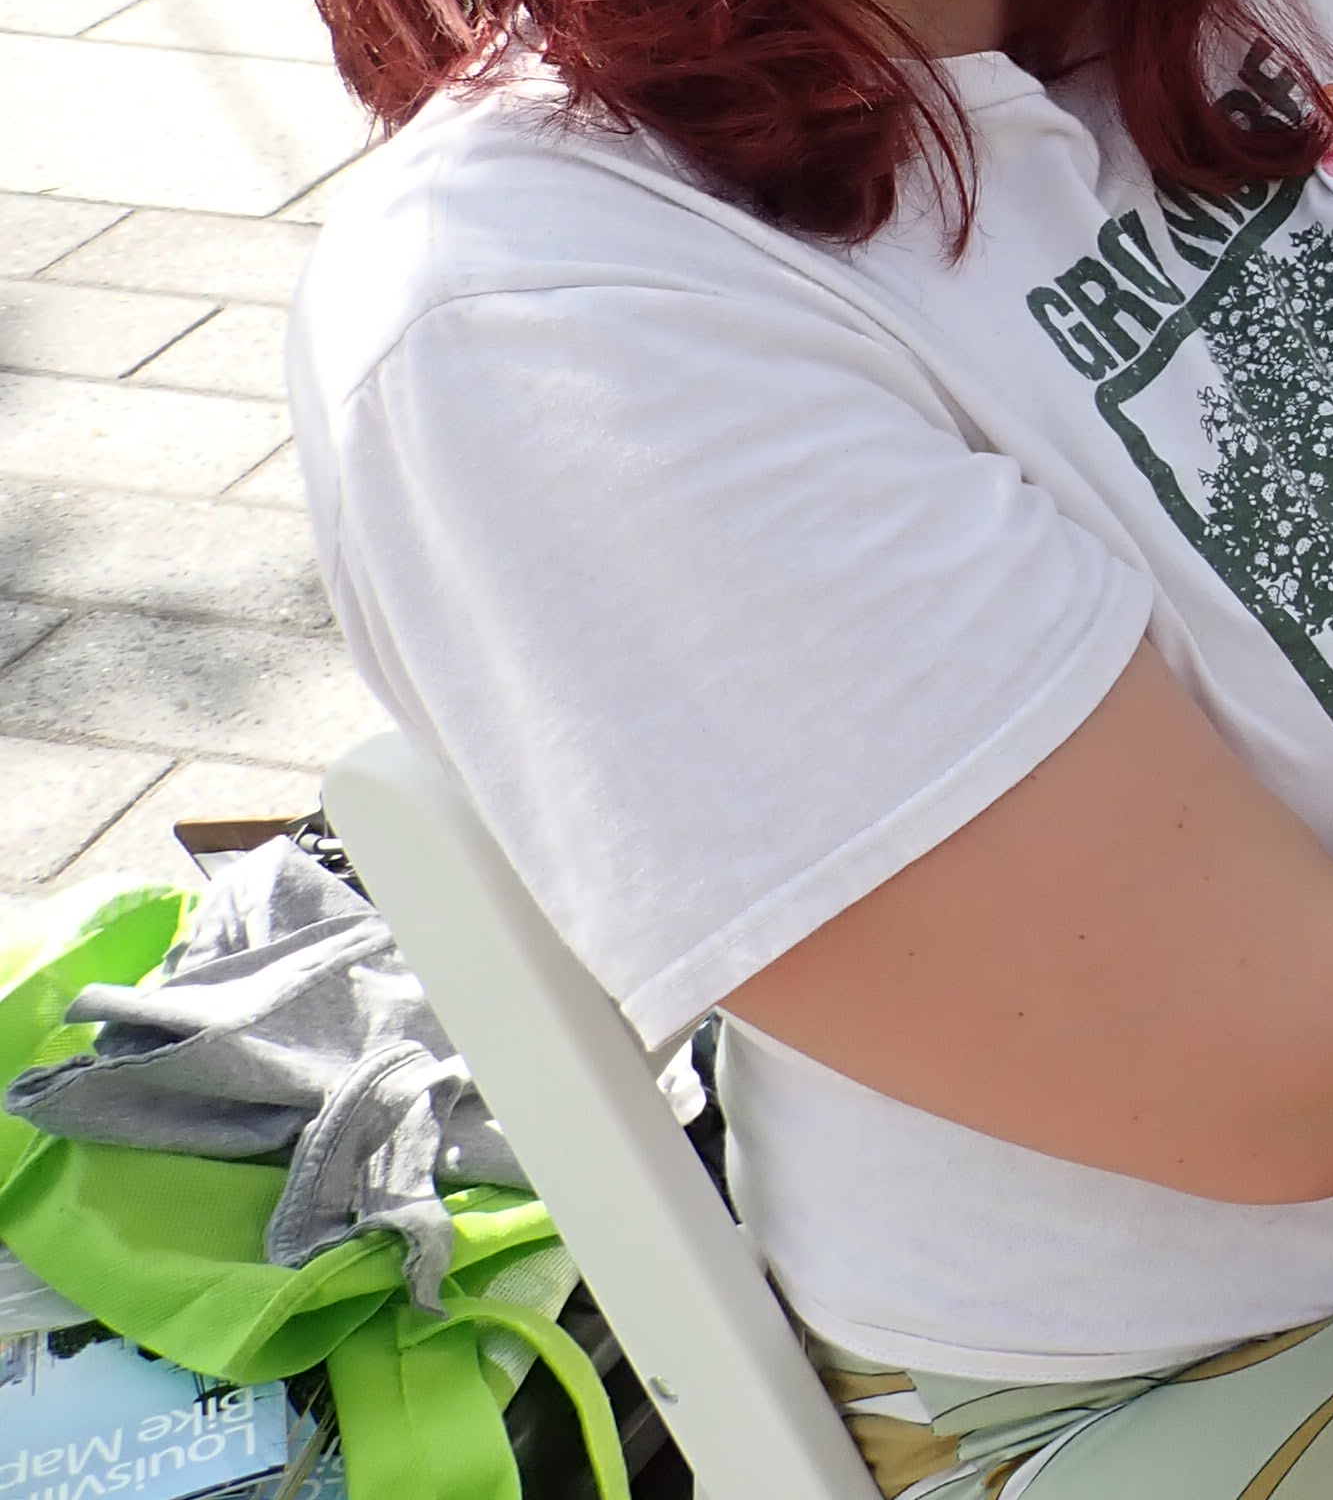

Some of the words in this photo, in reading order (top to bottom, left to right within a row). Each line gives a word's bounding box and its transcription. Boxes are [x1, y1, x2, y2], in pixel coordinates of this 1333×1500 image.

[137, 1386, 255, 1443] Bike
[0, 1426, 123, 1491] Map
[13, 1421, 256, 1500] Louisvi
